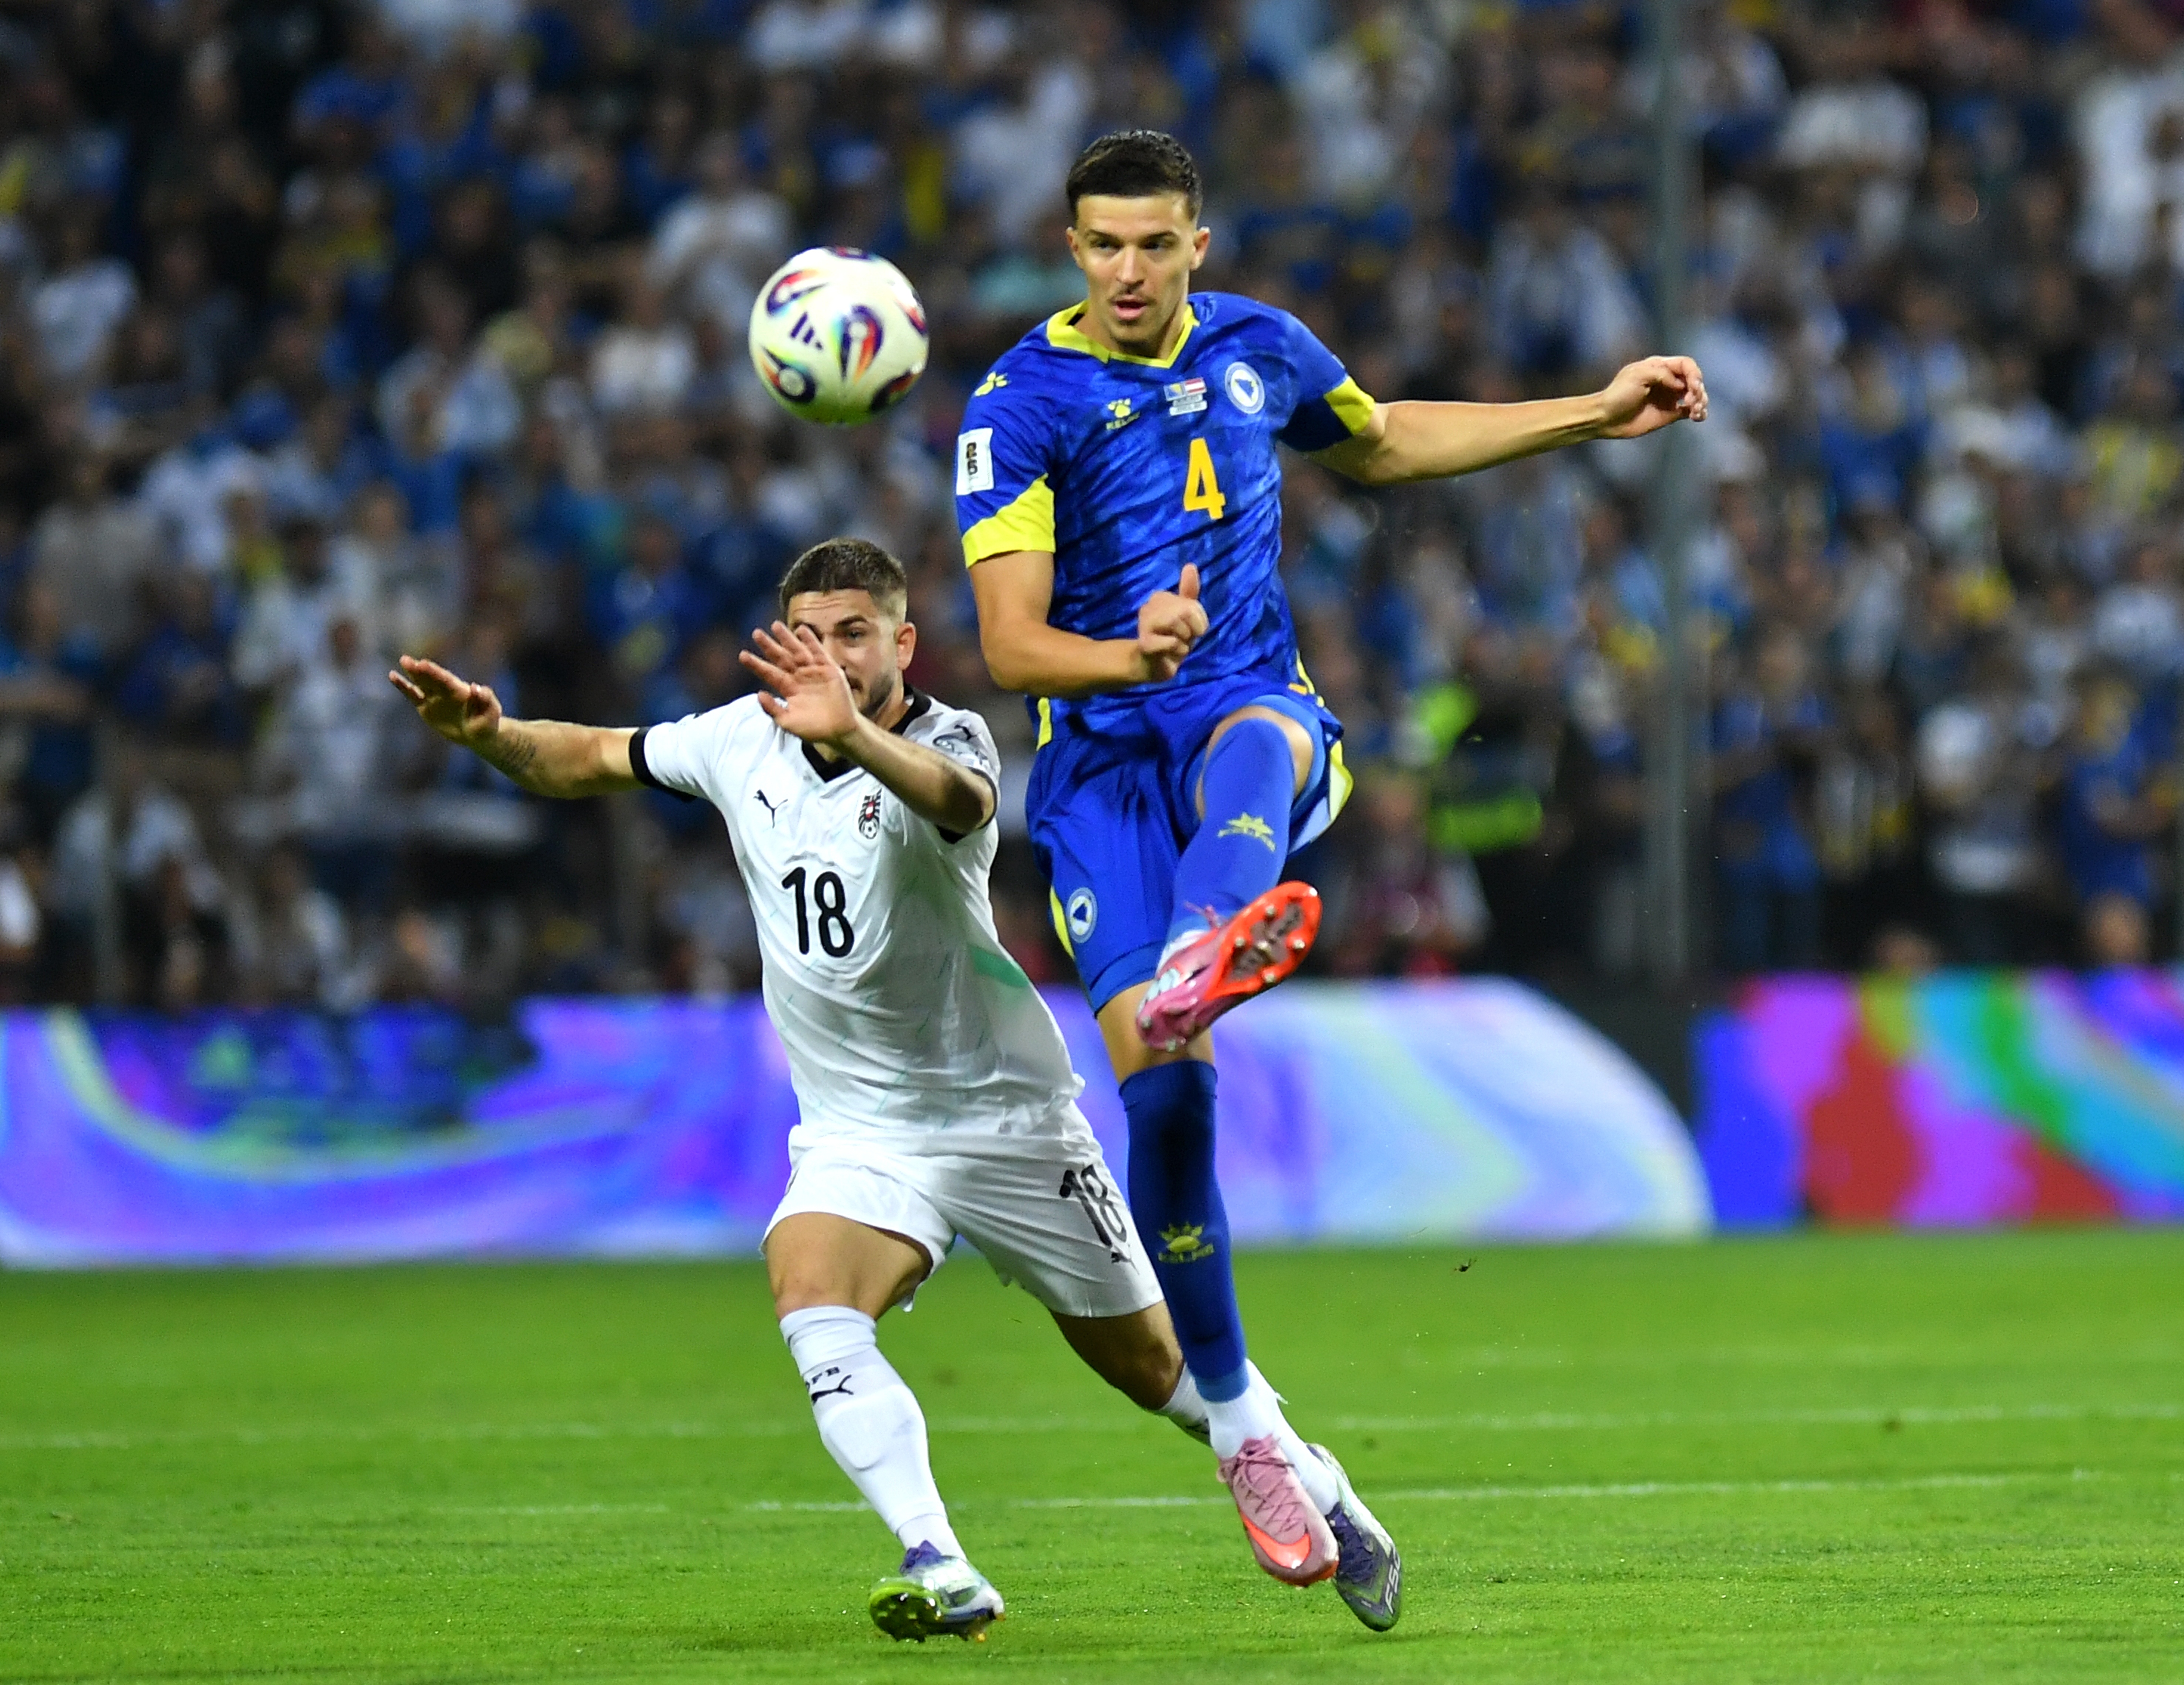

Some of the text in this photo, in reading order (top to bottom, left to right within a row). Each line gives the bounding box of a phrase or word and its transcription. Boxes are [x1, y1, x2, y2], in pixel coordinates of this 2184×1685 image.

[1183, 437, 1226, 520] 4
[781, 867, 854, 957] 18
[1059, 1164, 1127, 1247] 18
